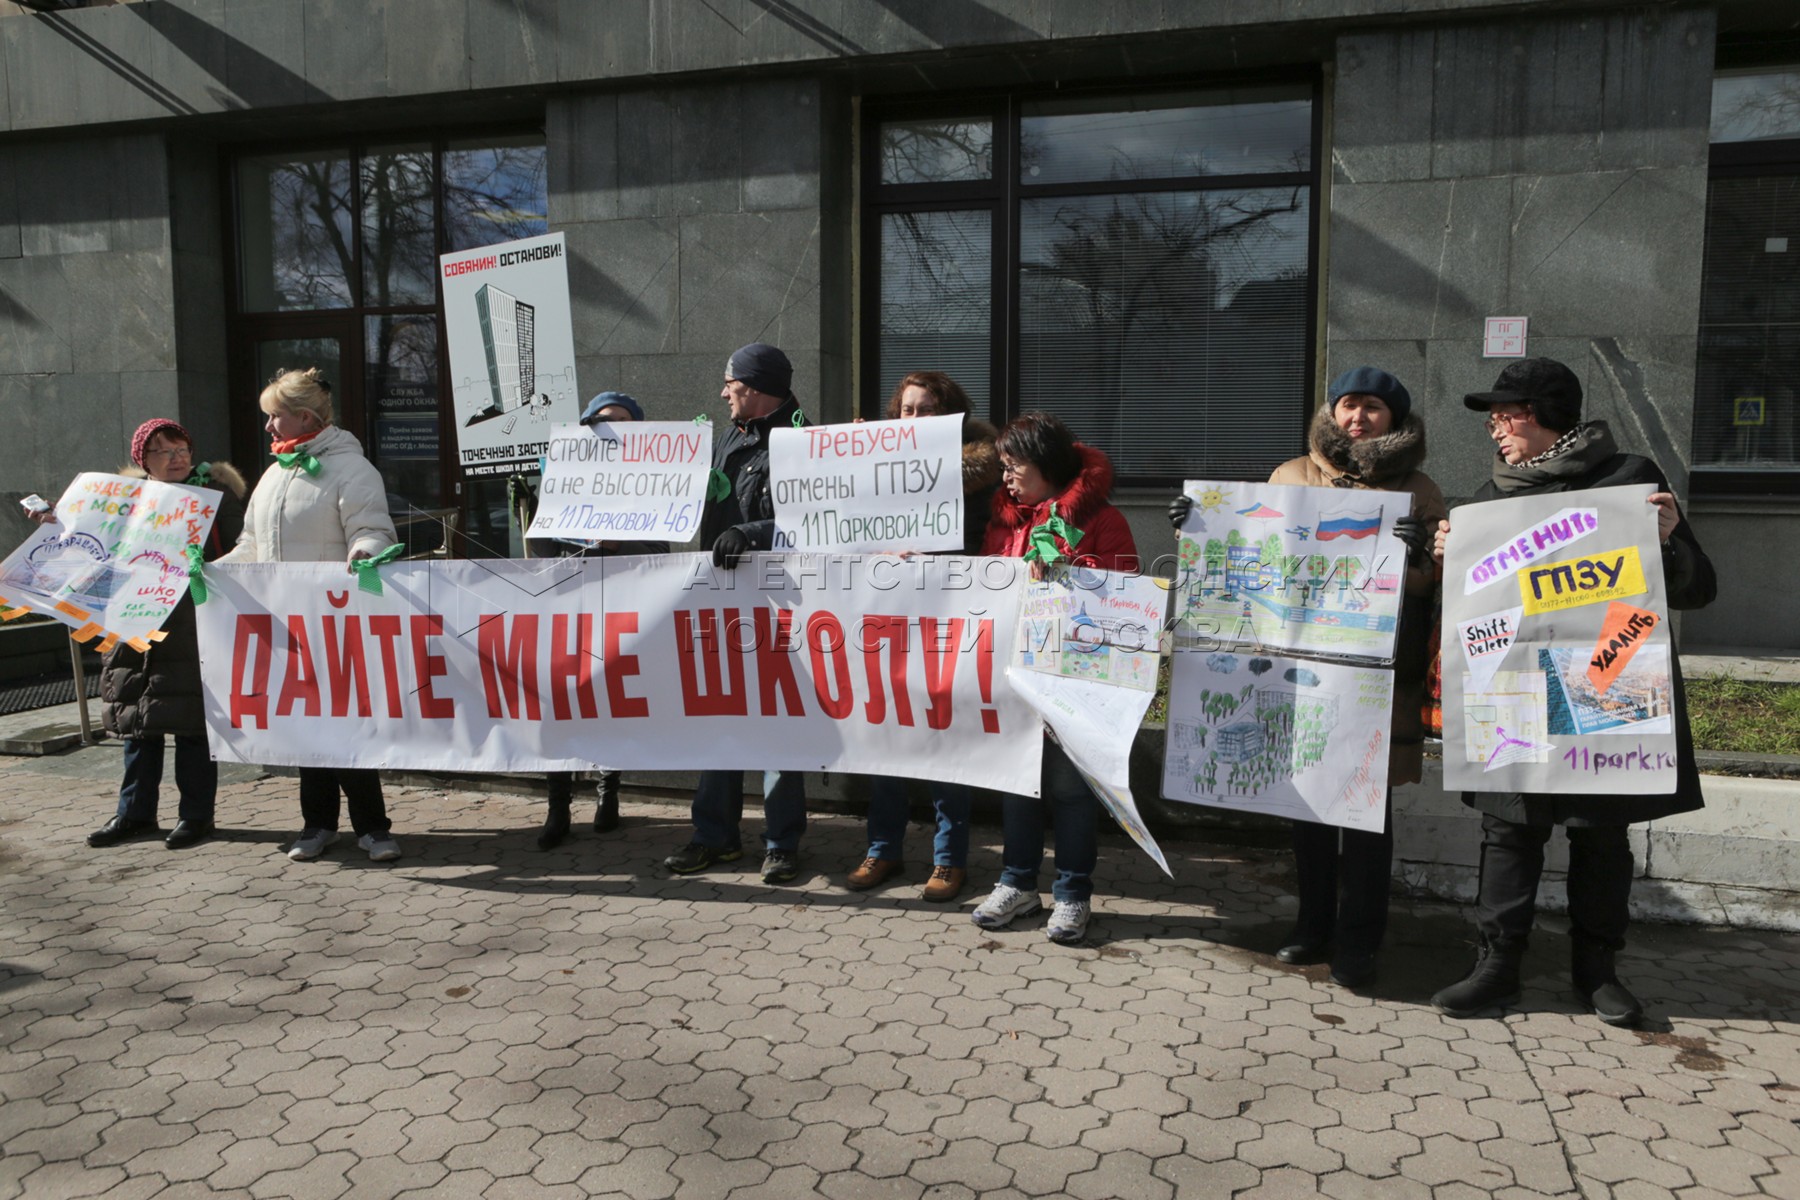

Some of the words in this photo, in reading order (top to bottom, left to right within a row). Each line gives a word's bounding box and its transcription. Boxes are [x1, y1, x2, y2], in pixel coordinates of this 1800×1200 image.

[444, 256, 497, 278] СОБЯНИН!
[500, 243, 562, 267] ОСТАНОВИ!
[1499, 323, 1514, 333] ПГ
[390, 388, 425, 397] СЛУЖБА
[462, 445, 516, 462] ТОЧЕЧНУЮ
[465, 468, 474, 476] НА
[474, 466, 495, 475] МЕСТЕ
[495, 463, 514, 473] ШКОЛ
[515, 463, 521, 471] И
[544, 477, 556, 495] а
[561, 476, 584, 496] не
[592, 472, 692, 497] ВЫСОТКИ
[874, 457, 943, 496] ГПЗУ
[533, 515, 554, 530] на
[664, 499, 702, 533] 46!
[775, 529, 797, 548] по
[922, 497, 960, 536] 46!
[1472, 511, 1597, 585] ОТМЕНИТЬ
[1529, 555, 1625, 600] ГПЗУ
[1466, 618, 1508, 642] Shift
[1468, 636, 1509, 657] Delete
[1590, 612, 1661, 672] УДАЛИТЬ
[229, 590, 456, 730] ДАЙТЕ
[477, 611, 650, 722] МНЕ
[673, 606, 1001, 734] ШКОЛУ!
